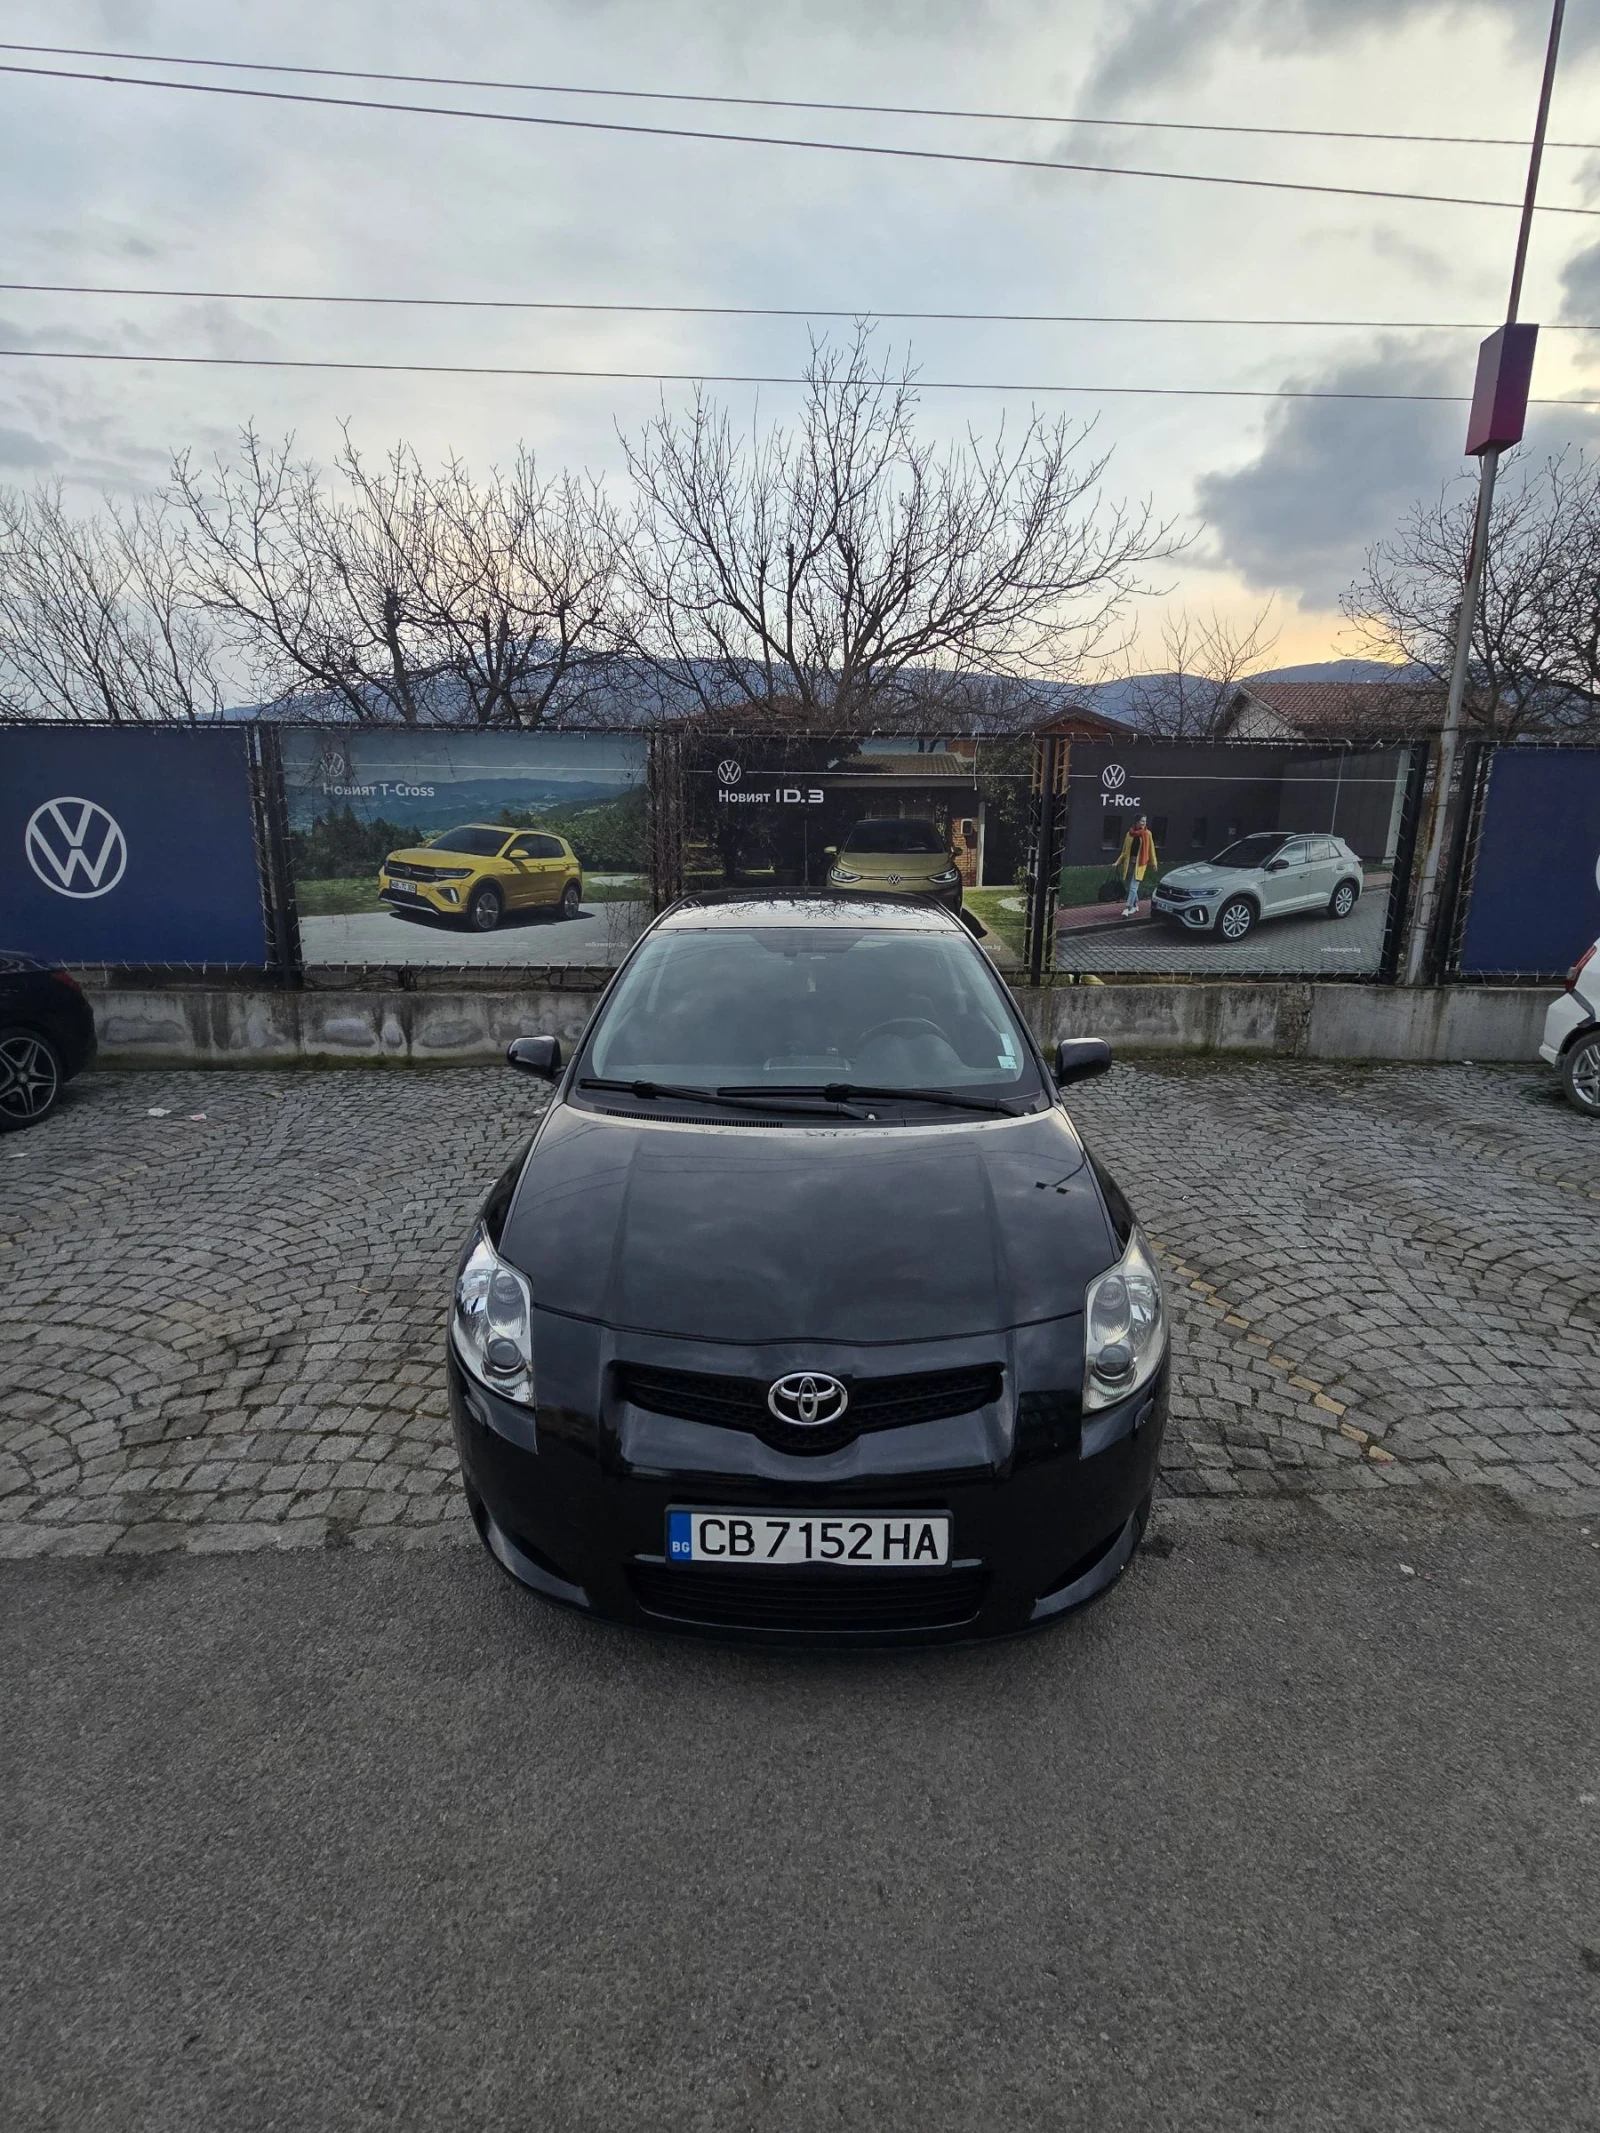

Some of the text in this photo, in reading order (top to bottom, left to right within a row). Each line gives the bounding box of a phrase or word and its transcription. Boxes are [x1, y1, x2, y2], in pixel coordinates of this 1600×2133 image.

[718, 760, 742, 784] VW
[1102, 764, 1126, 789] VW
[379, 783, 435, 797] T-Cross
[718, 789, 824, 803] Новият ID.3
[1100, 794, 1141, 806] T-Roc
[25, 796, 127, 899] VW
[671, 1541, 690, 1553] BG
